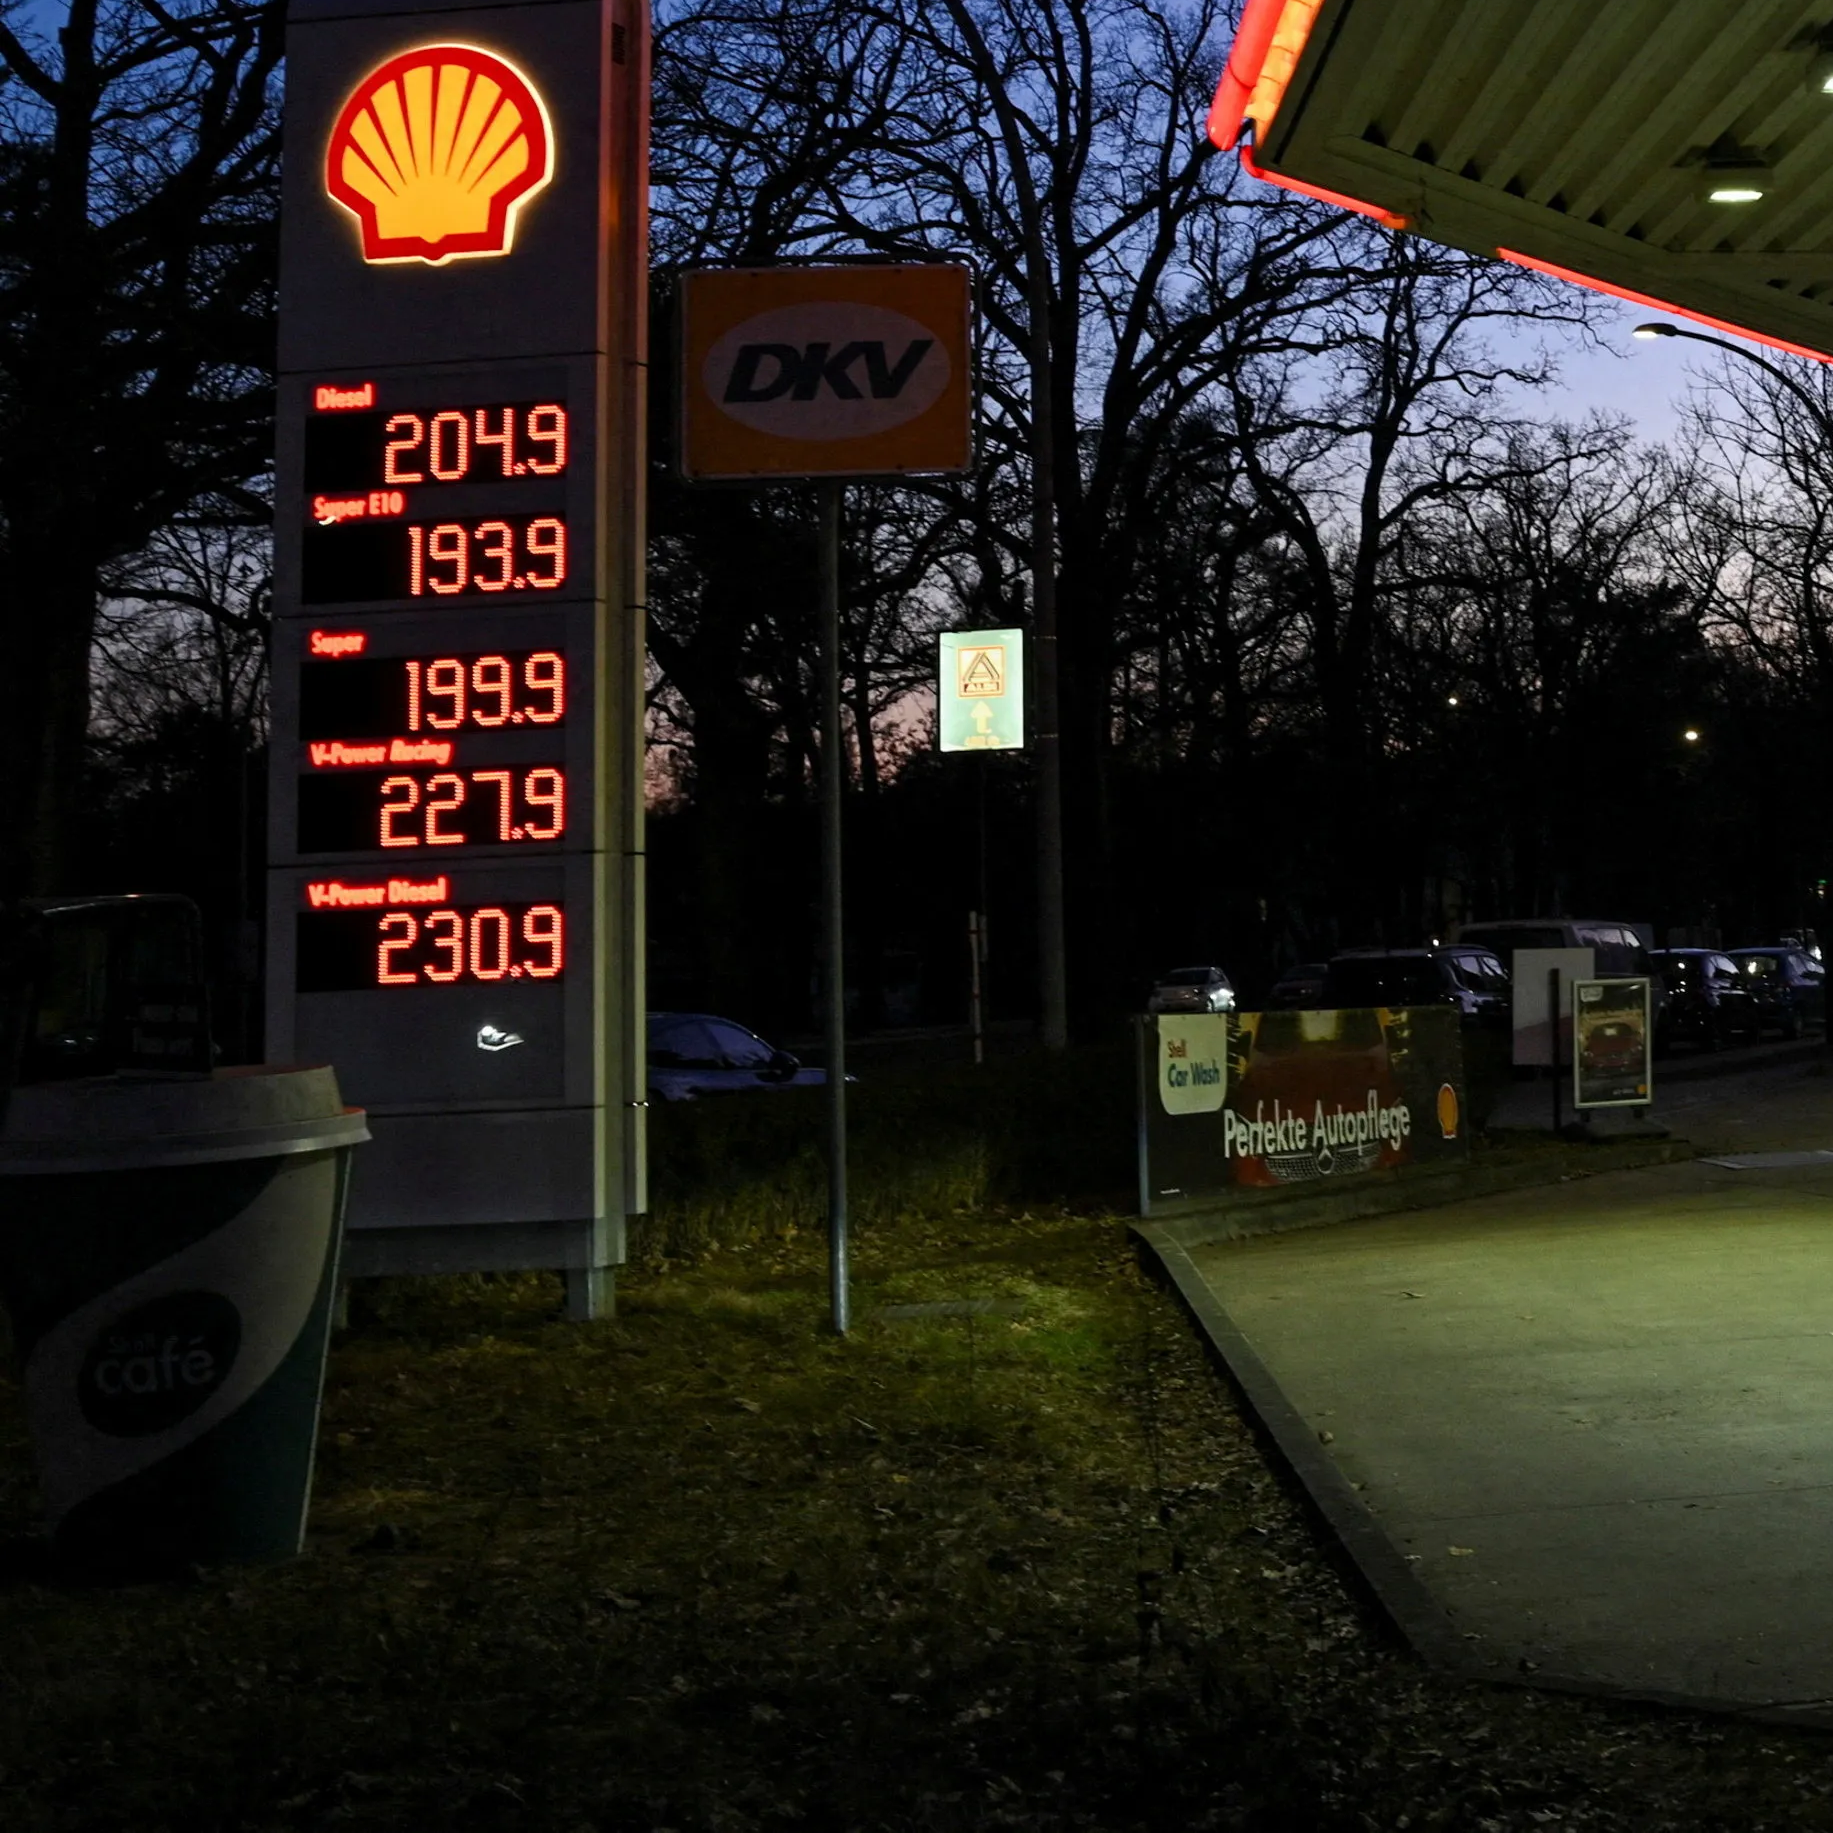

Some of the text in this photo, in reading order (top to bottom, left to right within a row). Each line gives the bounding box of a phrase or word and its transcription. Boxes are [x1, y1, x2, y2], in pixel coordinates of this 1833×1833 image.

[315, 384, 373, 409] Diesel
[723, 339, 934, 402] DKV
[385, 405, 565, 483] 204.9
[314, 493, 404, 522] Super E10
[408, 518, 565, 596] 193.9
[311, 632, 364, 656] Super
[406, 652, 564, 731] 199.9
[311, 742, 387, 765] V-Power
[380, 768, 564, 847] 227.9
[308, 877, 447, 906] V-Power Diesel
[378, 906, 562, 984] 230.9
[1168, 1062, 1219, 1088] Car Wash
[1223, 1089, 1411, 1159] Perfekte Autopflege
[95, 1335, 215, 1395] café
